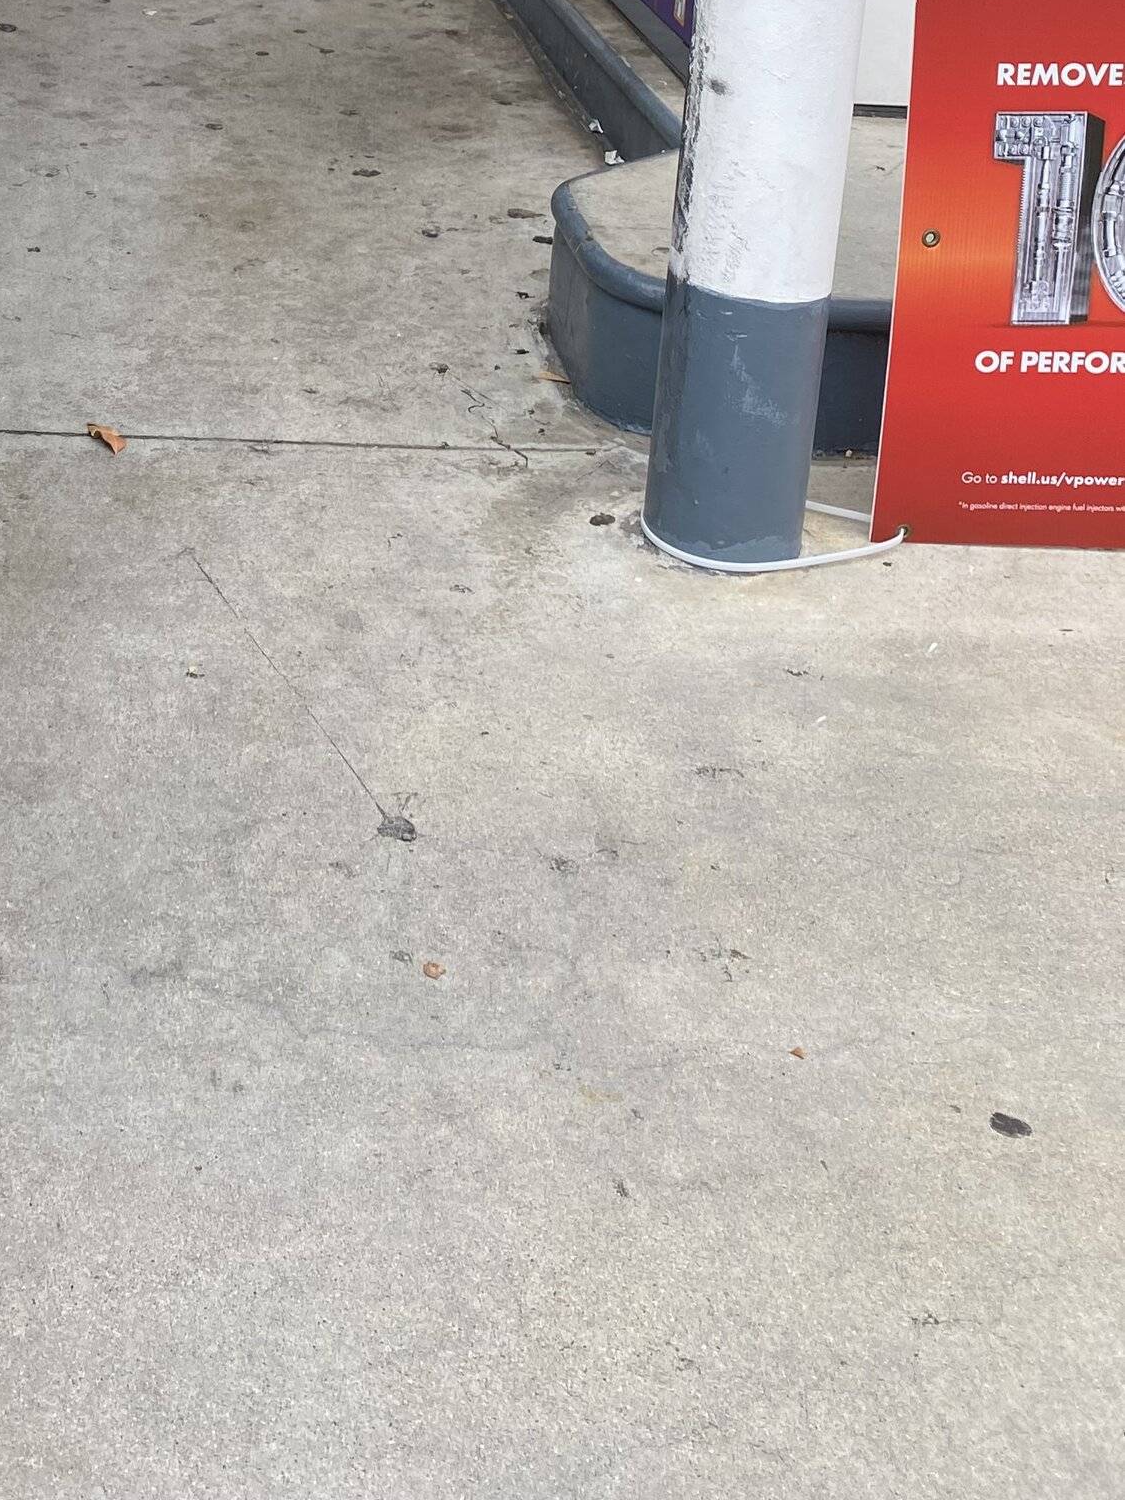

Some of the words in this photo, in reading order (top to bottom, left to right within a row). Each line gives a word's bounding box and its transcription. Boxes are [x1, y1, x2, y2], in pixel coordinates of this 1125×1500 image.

[996, 63, 1125, 87] REMOVE
[975, 350, 1015, 374] OF
[1020, 350, 1125, 375] PERFOR
[961, 471, 982, 485] Go
[985, 472, 998, 485] to
